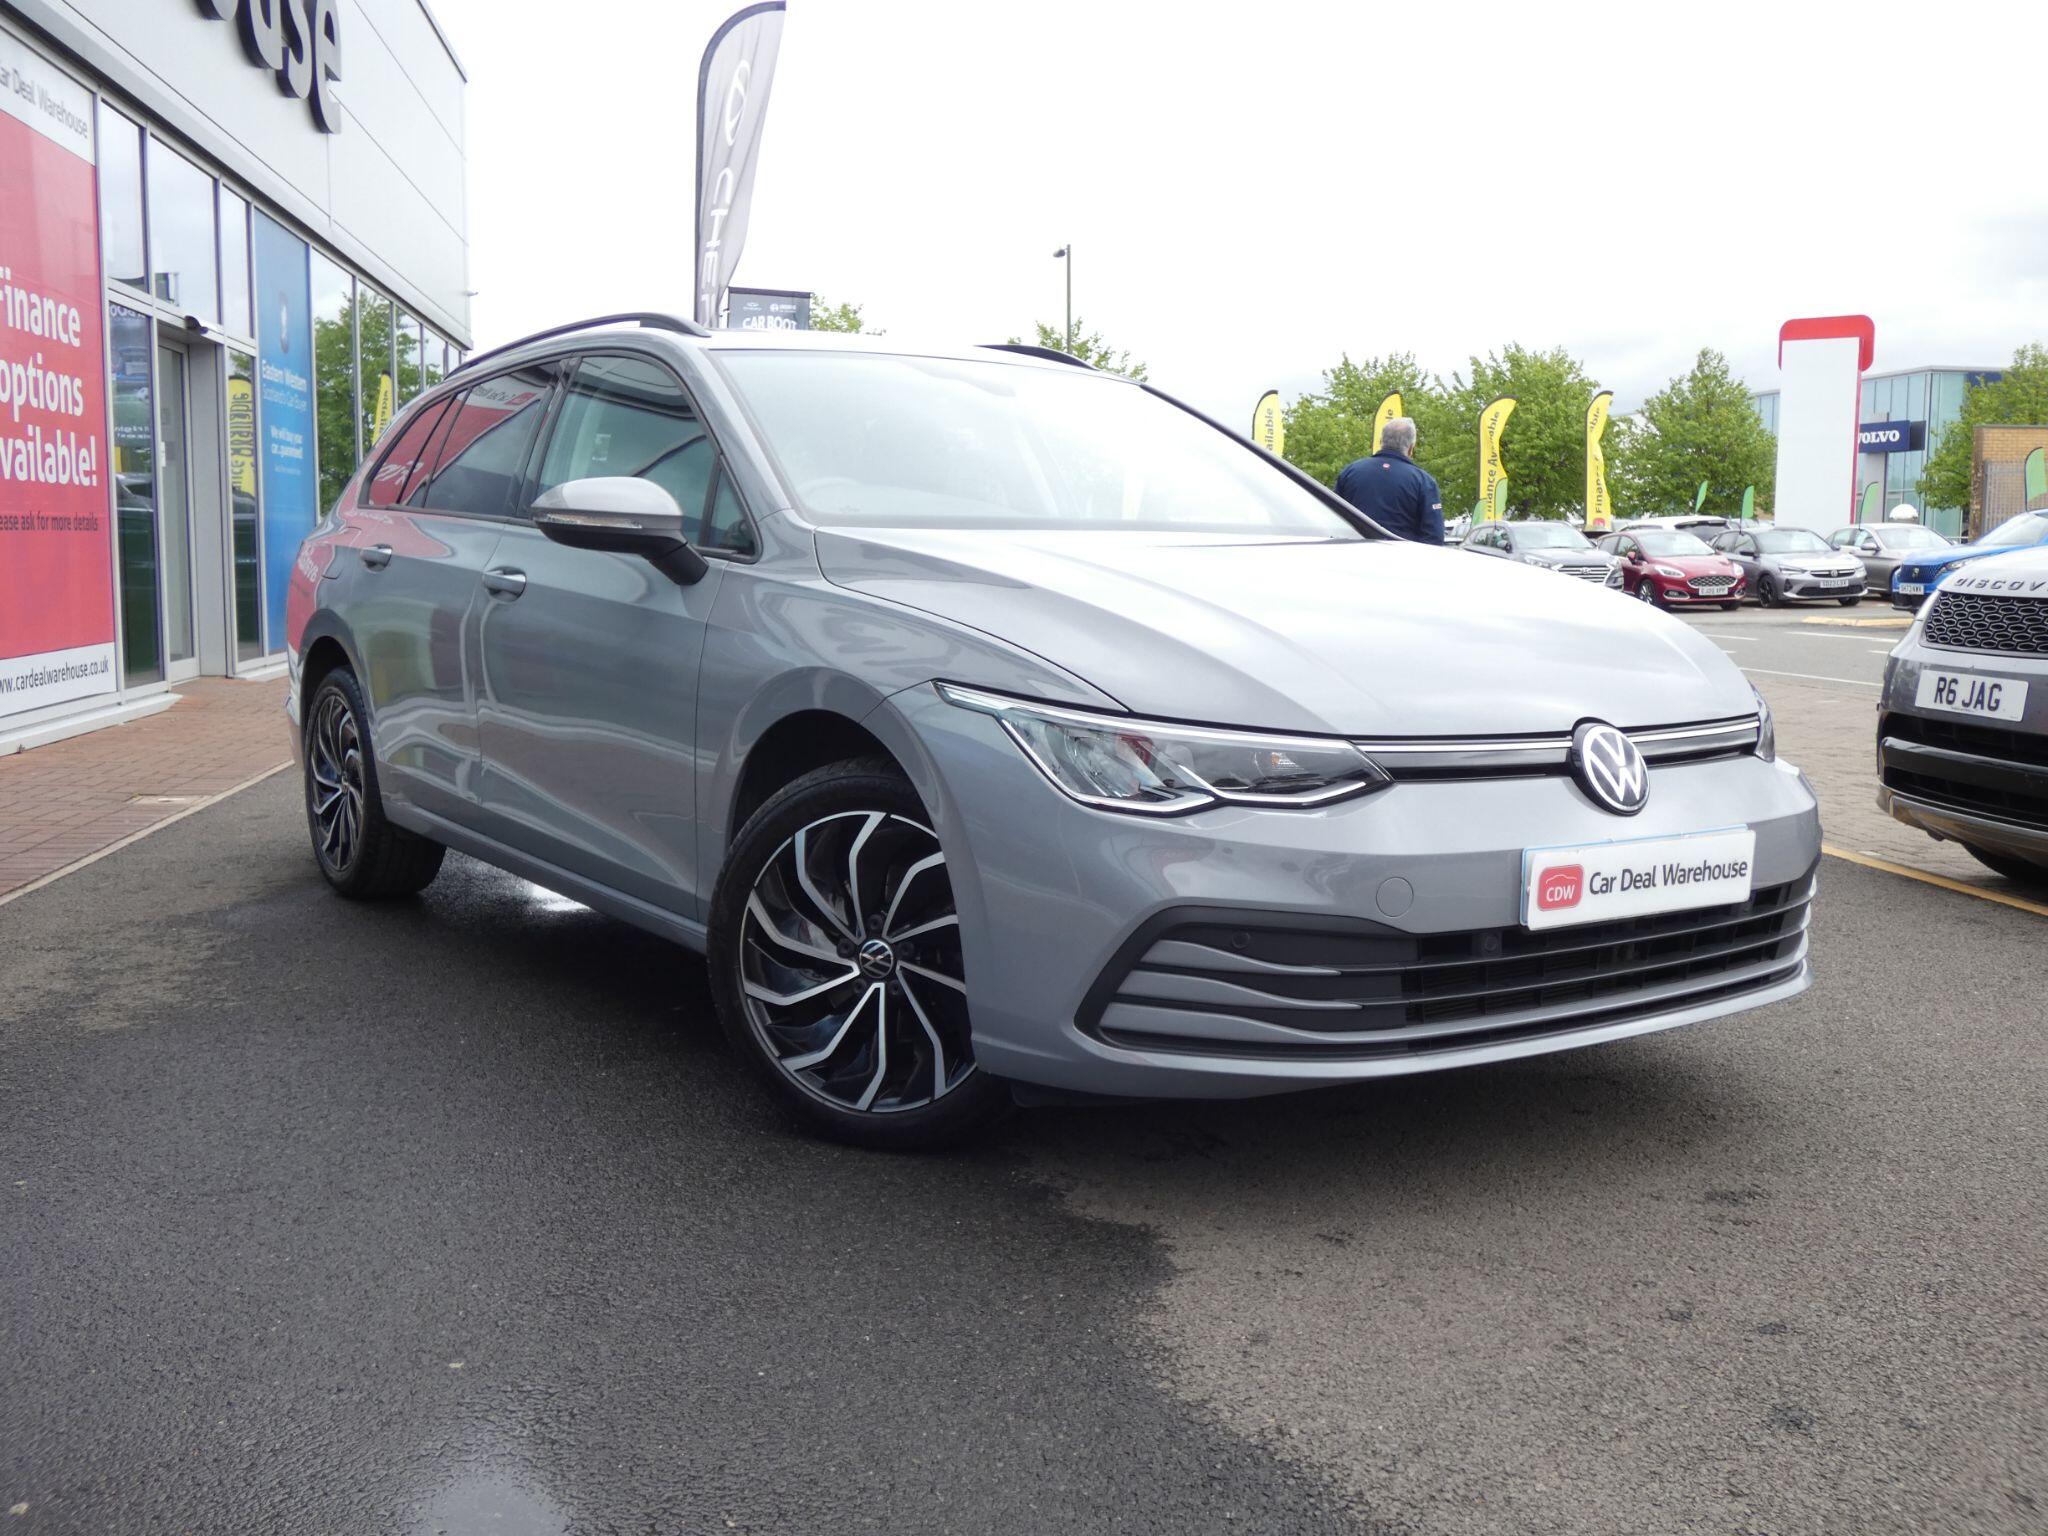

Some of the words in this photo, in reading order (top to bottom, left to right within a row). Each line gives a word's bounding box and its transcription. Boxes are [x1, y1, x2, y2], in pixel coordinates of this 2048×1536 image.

[192, 0, 342, 134] use
[13, 68, 36, 105] Deal
[37, 84, 88, 139] Warehouse
[0, 266, 81, 347] inance
[742, 315, 766, 329] CAR
[0, 352, 83, 422] options
[21, 511, 36, 531] ask
[37, 510, 49, 531] for
[51, 515, 72, 531] more
[74, 511, 98, 531] details
[1954, 578, 2048, 592] DISCOV
[1933, 676, 1959, 706] R6
[1961, 681, 2003, 712] JAG
[1546, 885, 1576, 902] CDW
[1589, 872, 1617, 895] Car
[1620, 865, 1657, 892] Deal
[1662, 859, 1748, 887] Warehouse
